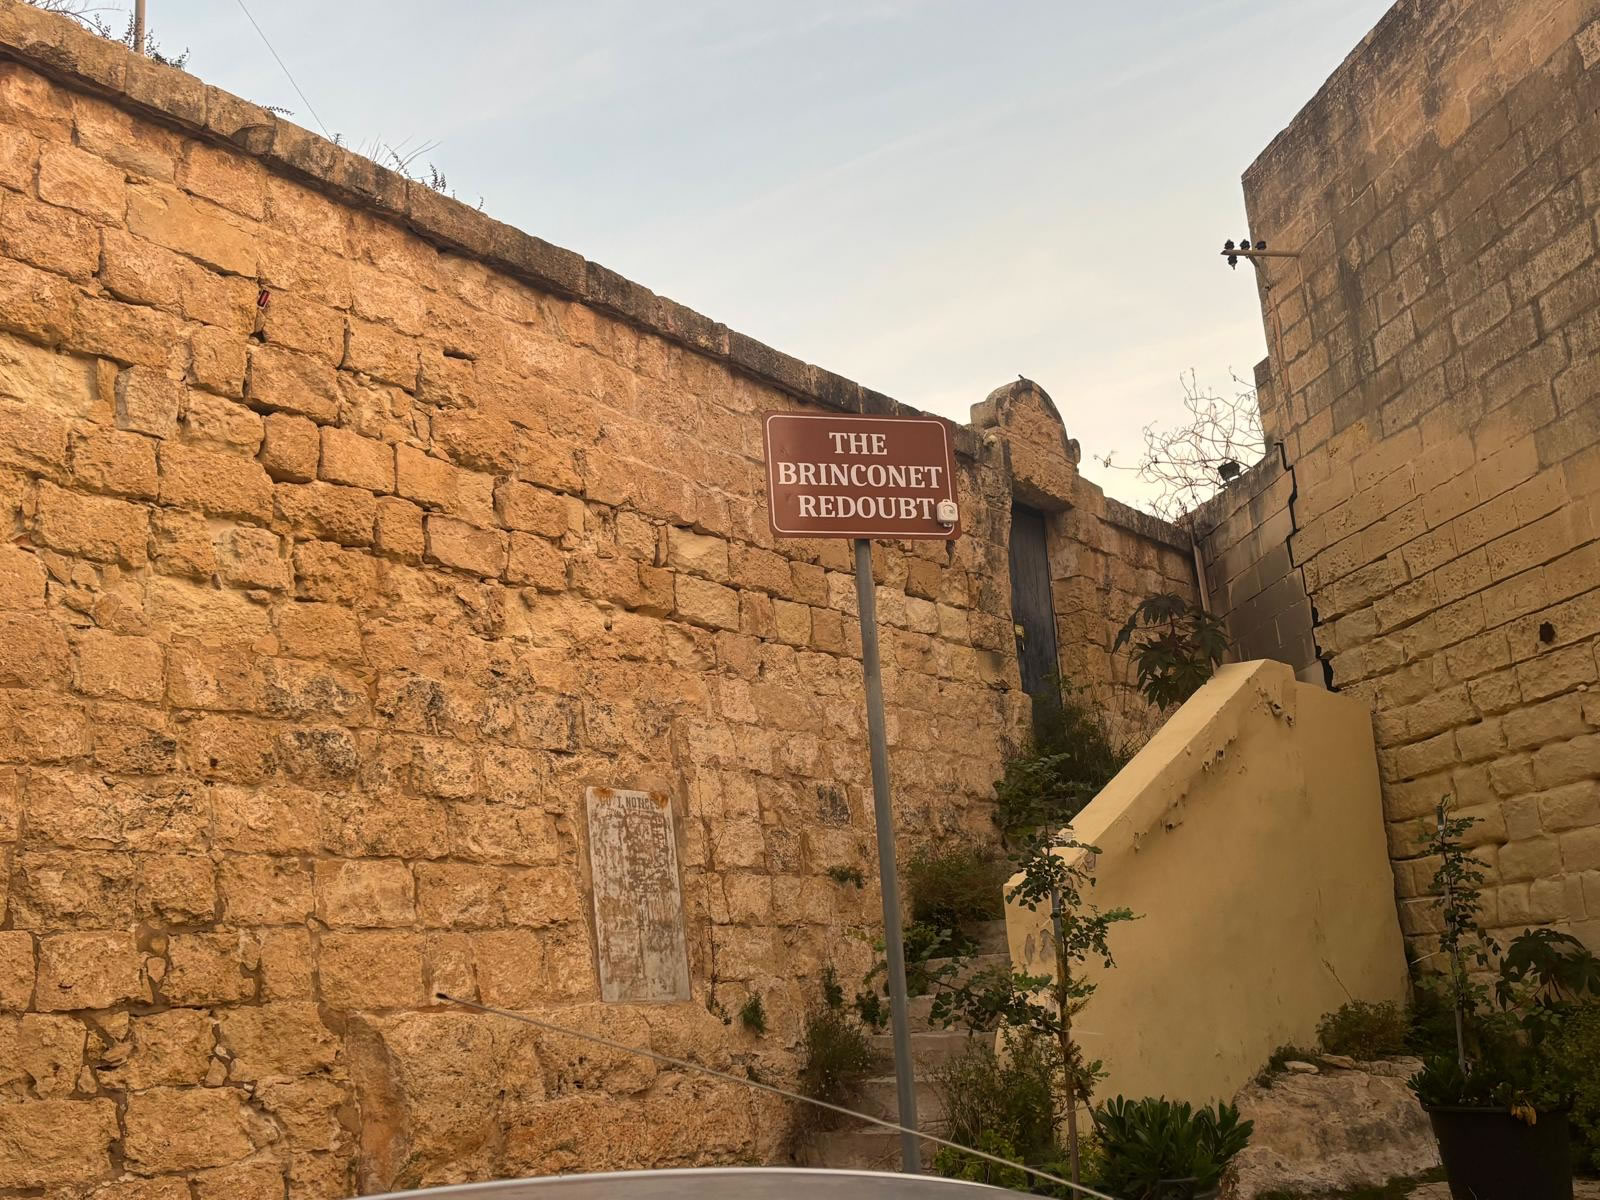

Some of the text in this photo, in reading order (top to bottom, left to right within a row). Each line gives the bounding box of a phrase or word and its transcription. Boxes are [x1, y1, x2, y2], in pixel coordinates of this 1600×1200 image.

[828, 431, 888, 456] THE
[777, 461, 943, 489] BRINCONET
[797, 494, 935, 520] REDOUBT
